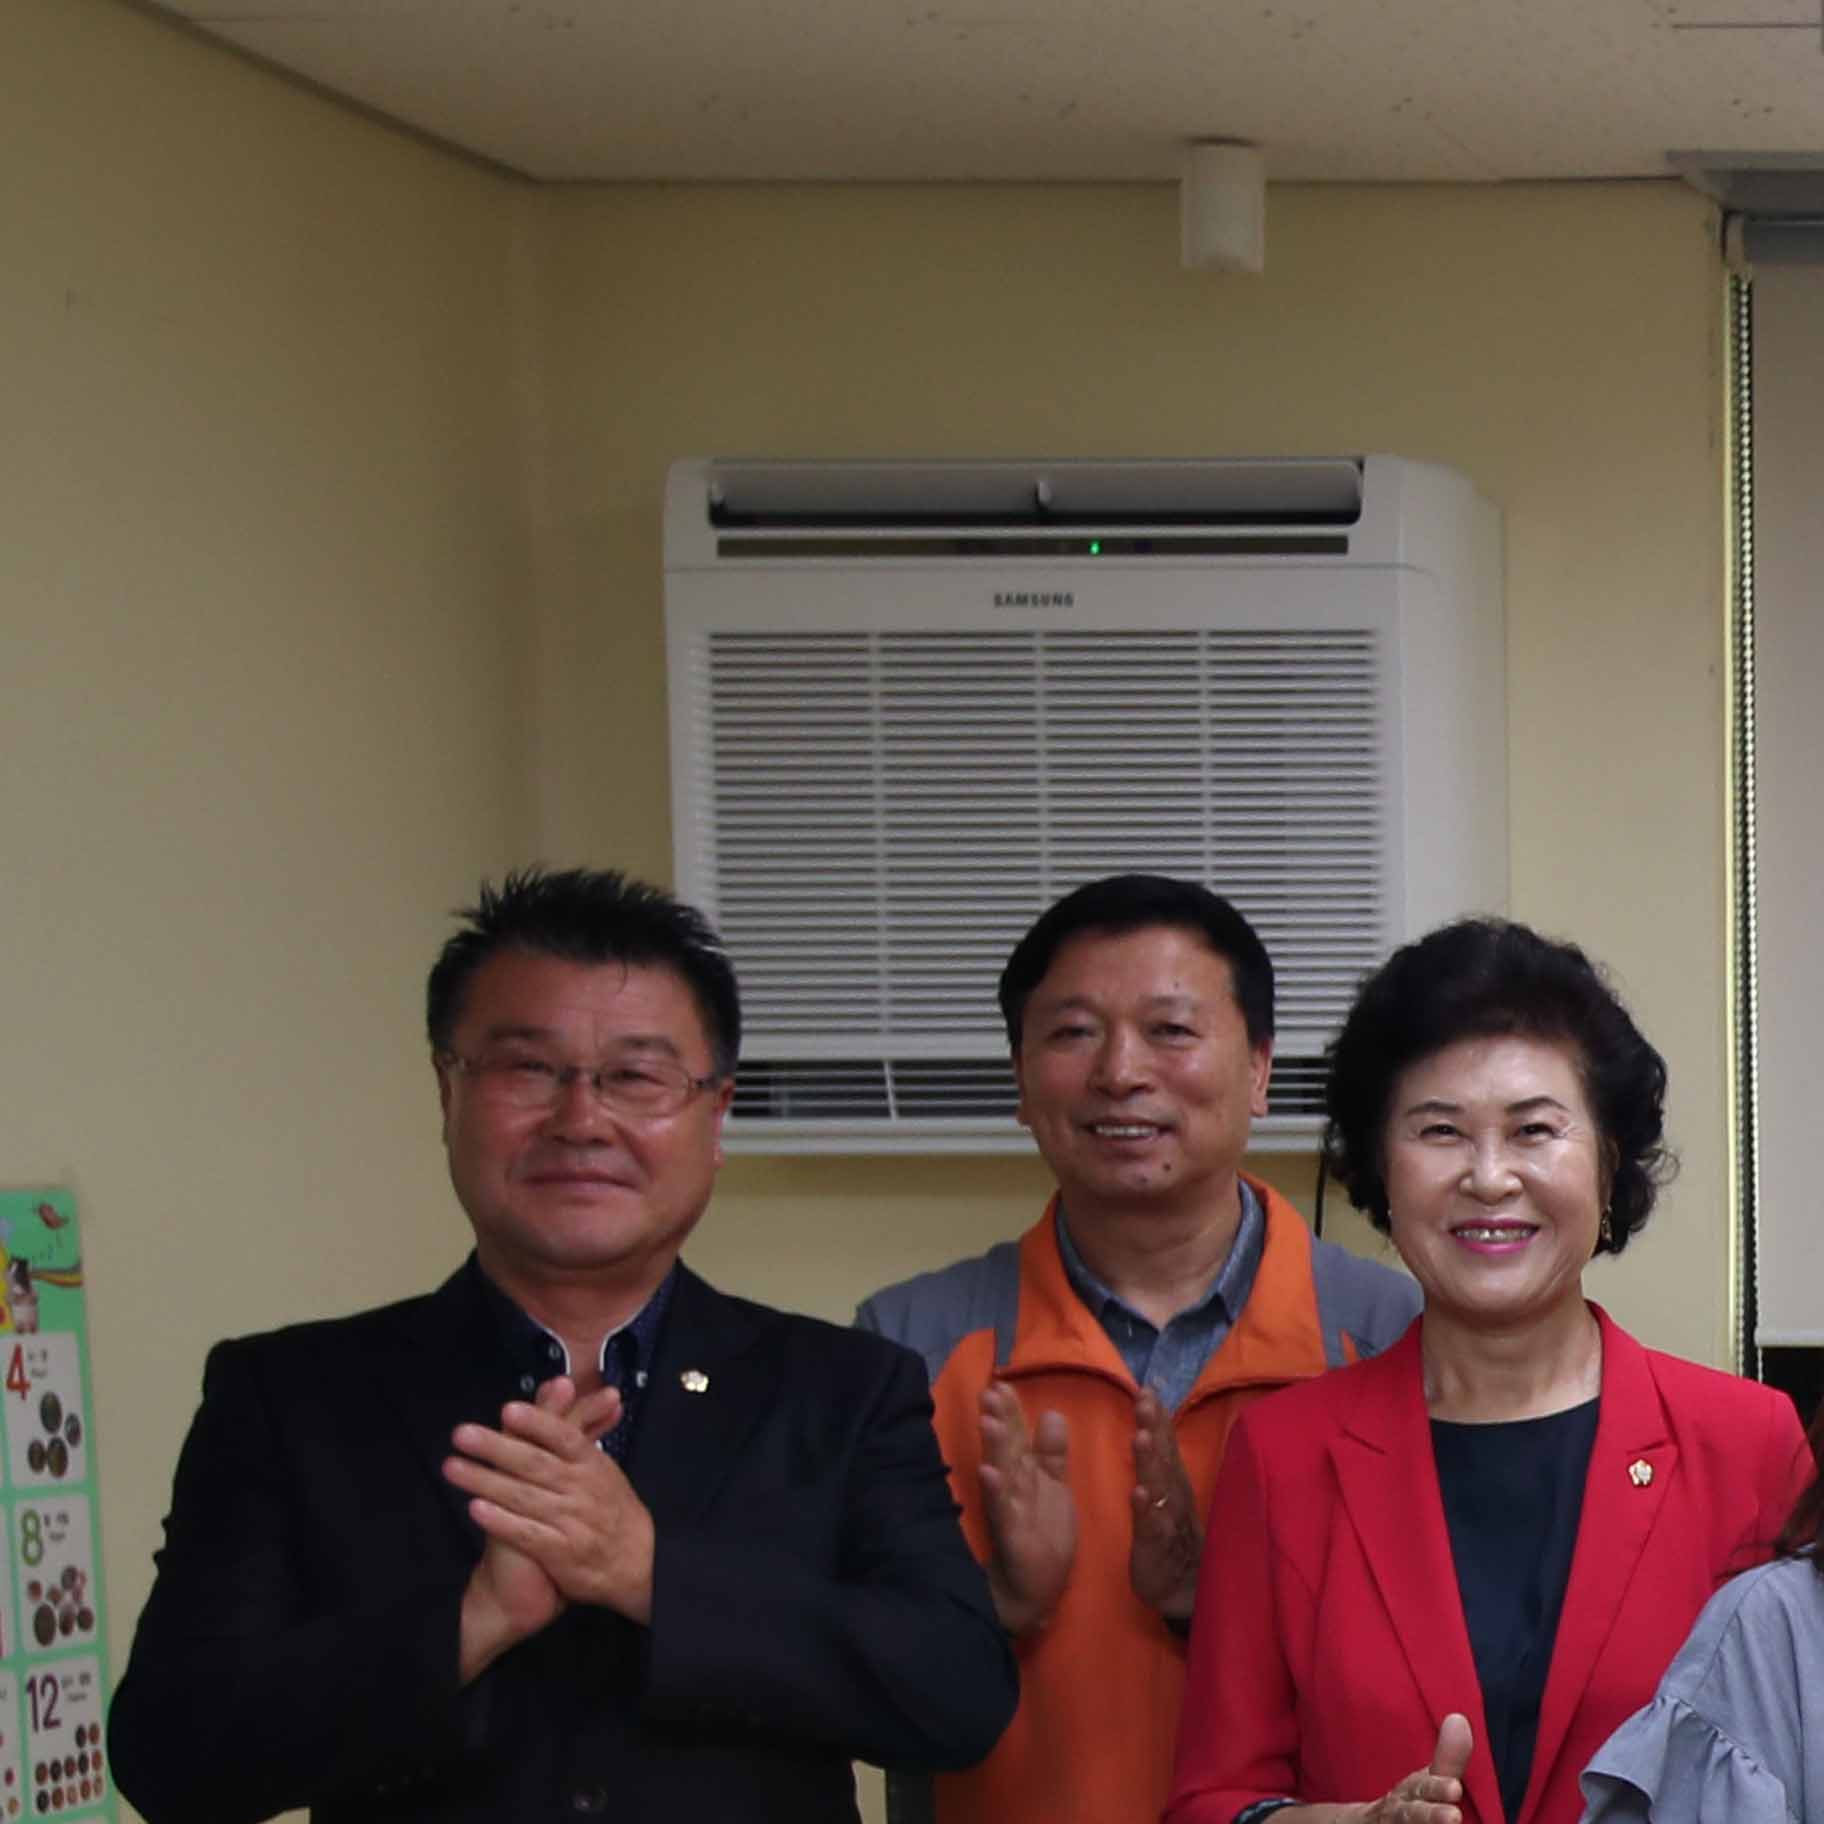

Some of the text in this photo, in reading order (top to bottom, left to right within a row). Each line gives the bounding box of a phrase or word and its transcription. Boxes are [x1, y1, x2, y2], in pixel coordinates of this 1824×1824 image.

[993, 592, 1075, 608] SAMSUNG
[6, 1343, 31, 1400] 4
[20, 1508, 44, 1568] 8
[26, 1674, 62, 1733] 12
